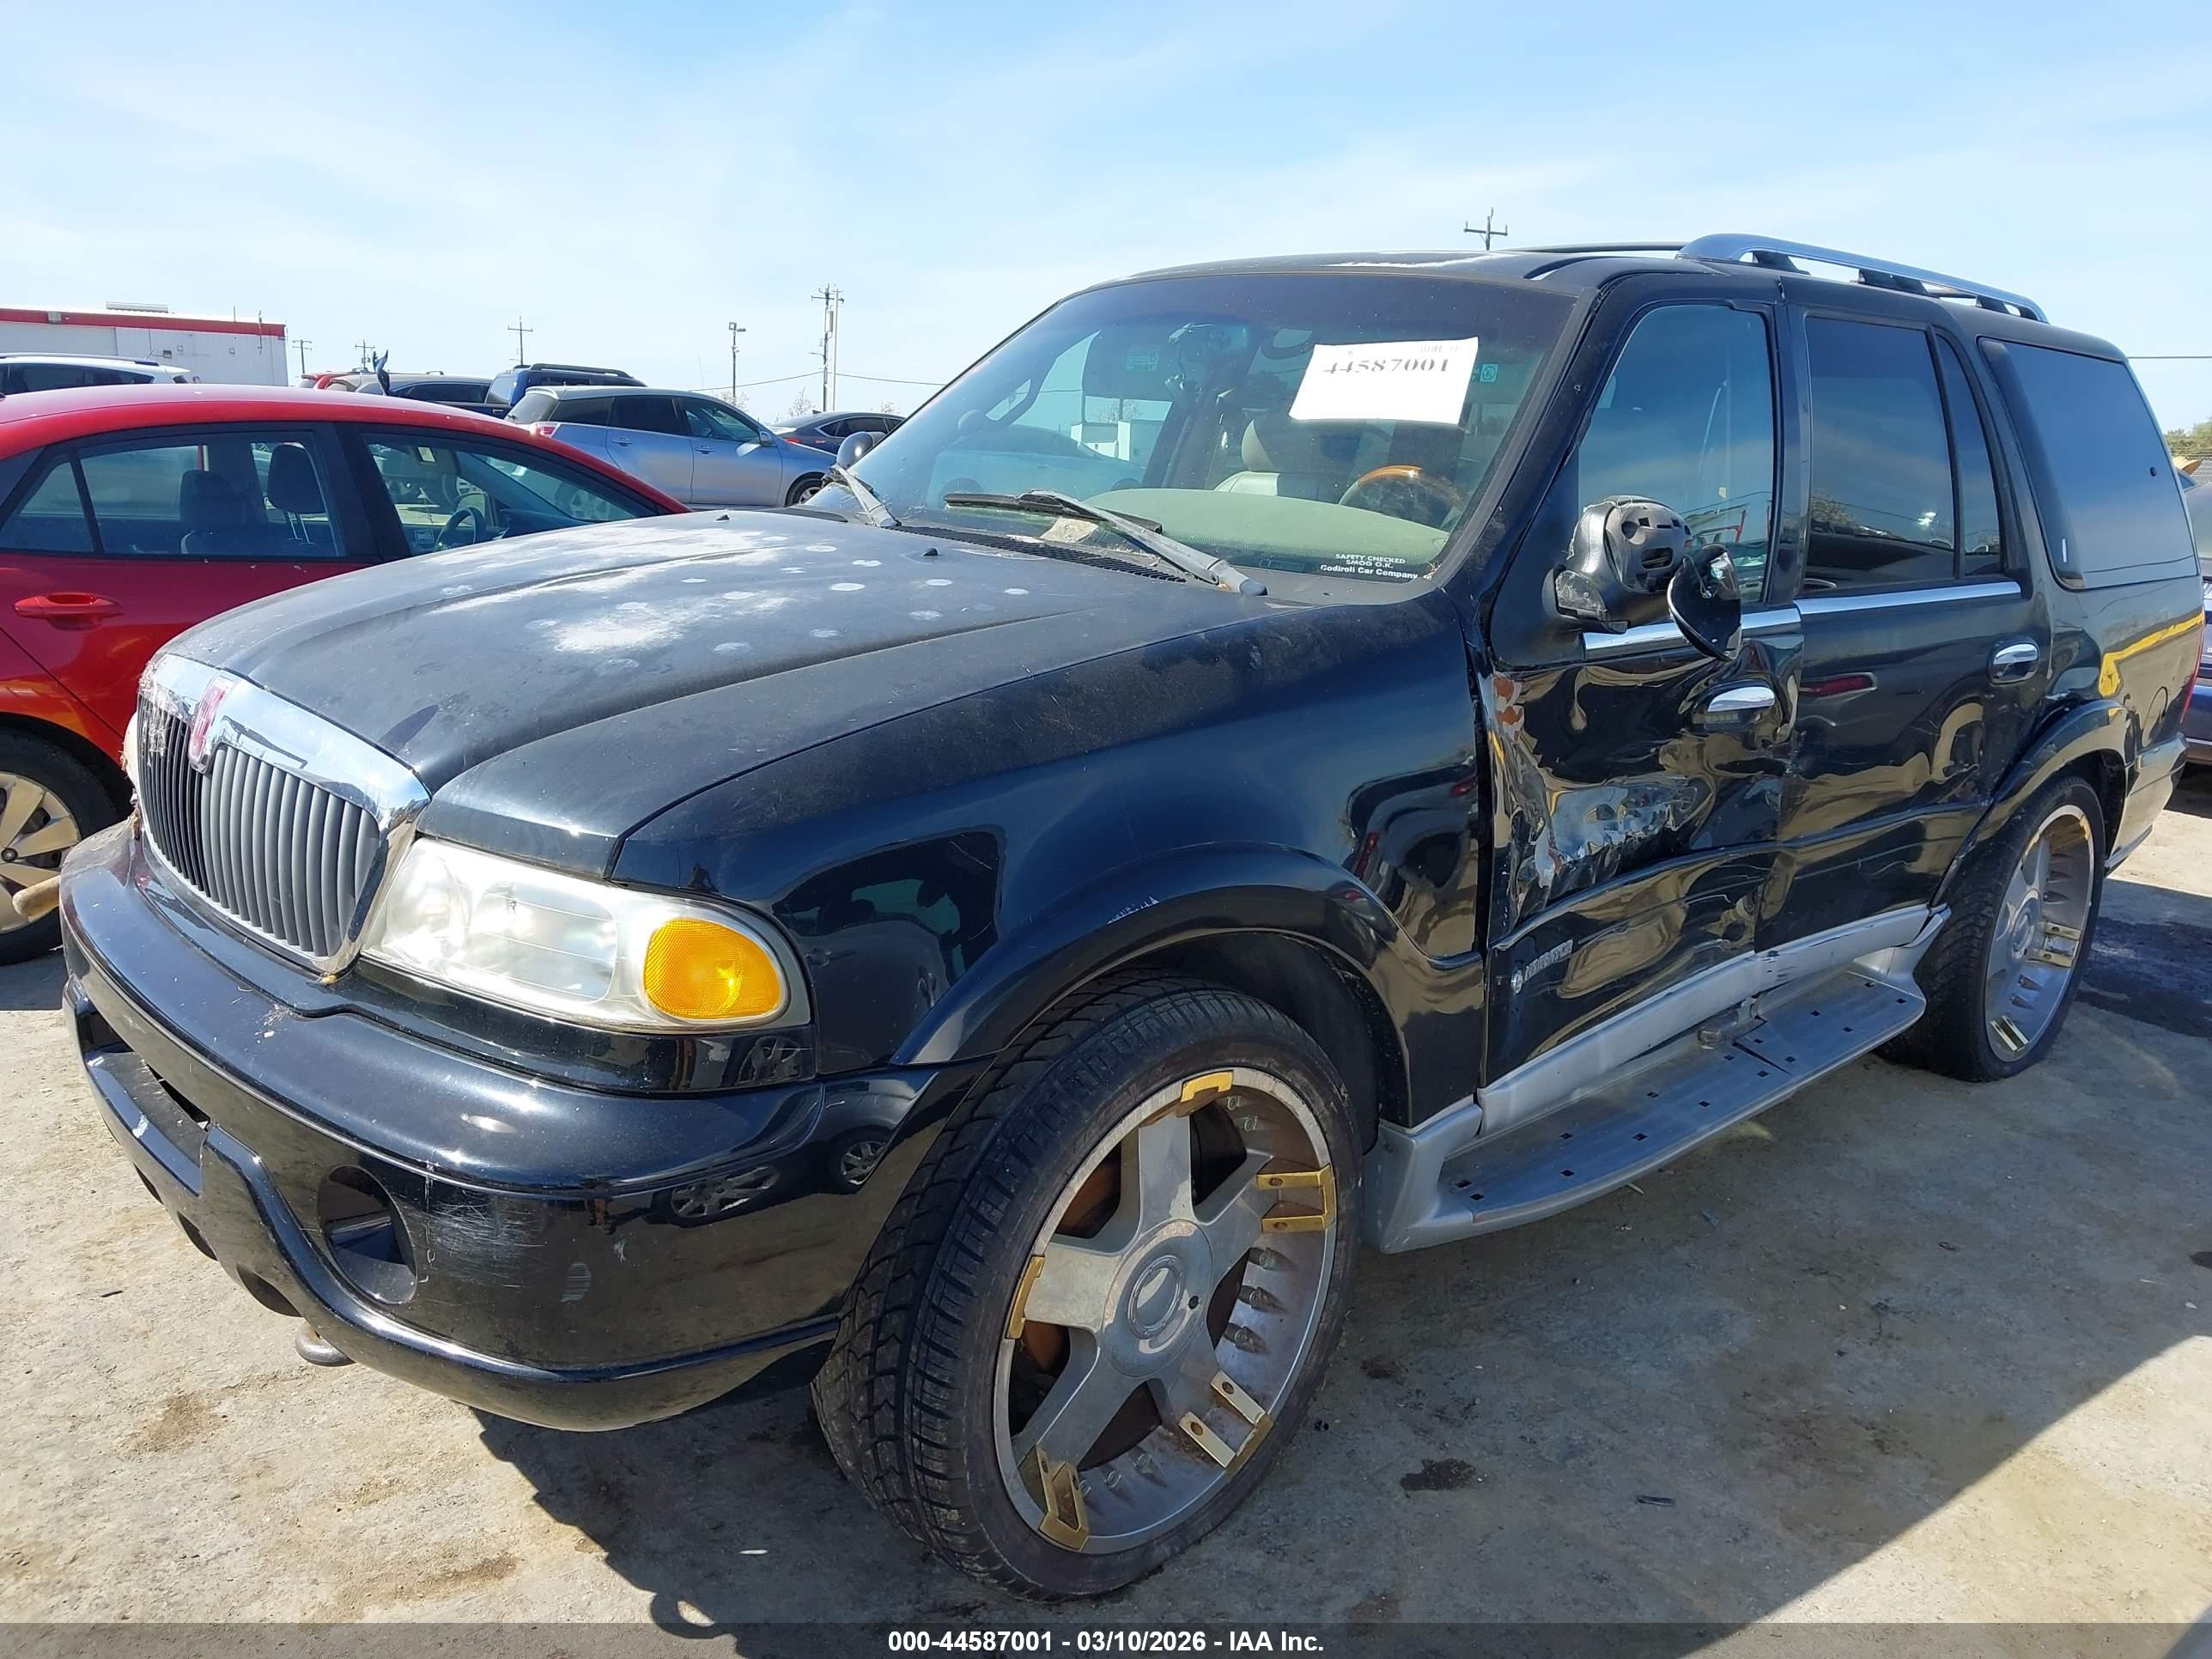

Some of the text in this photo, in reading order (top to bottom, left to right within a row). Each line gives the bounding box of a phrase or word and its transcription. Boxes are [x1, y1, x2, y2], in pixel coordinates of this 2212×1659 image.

[1322, 357, 1449, 374] 44587001
[1335, 553, 1406, 564] SAFETY CHECKED
[1358, 566, 1374, 574] Car
[1376, 568, 1419, 580] Company
